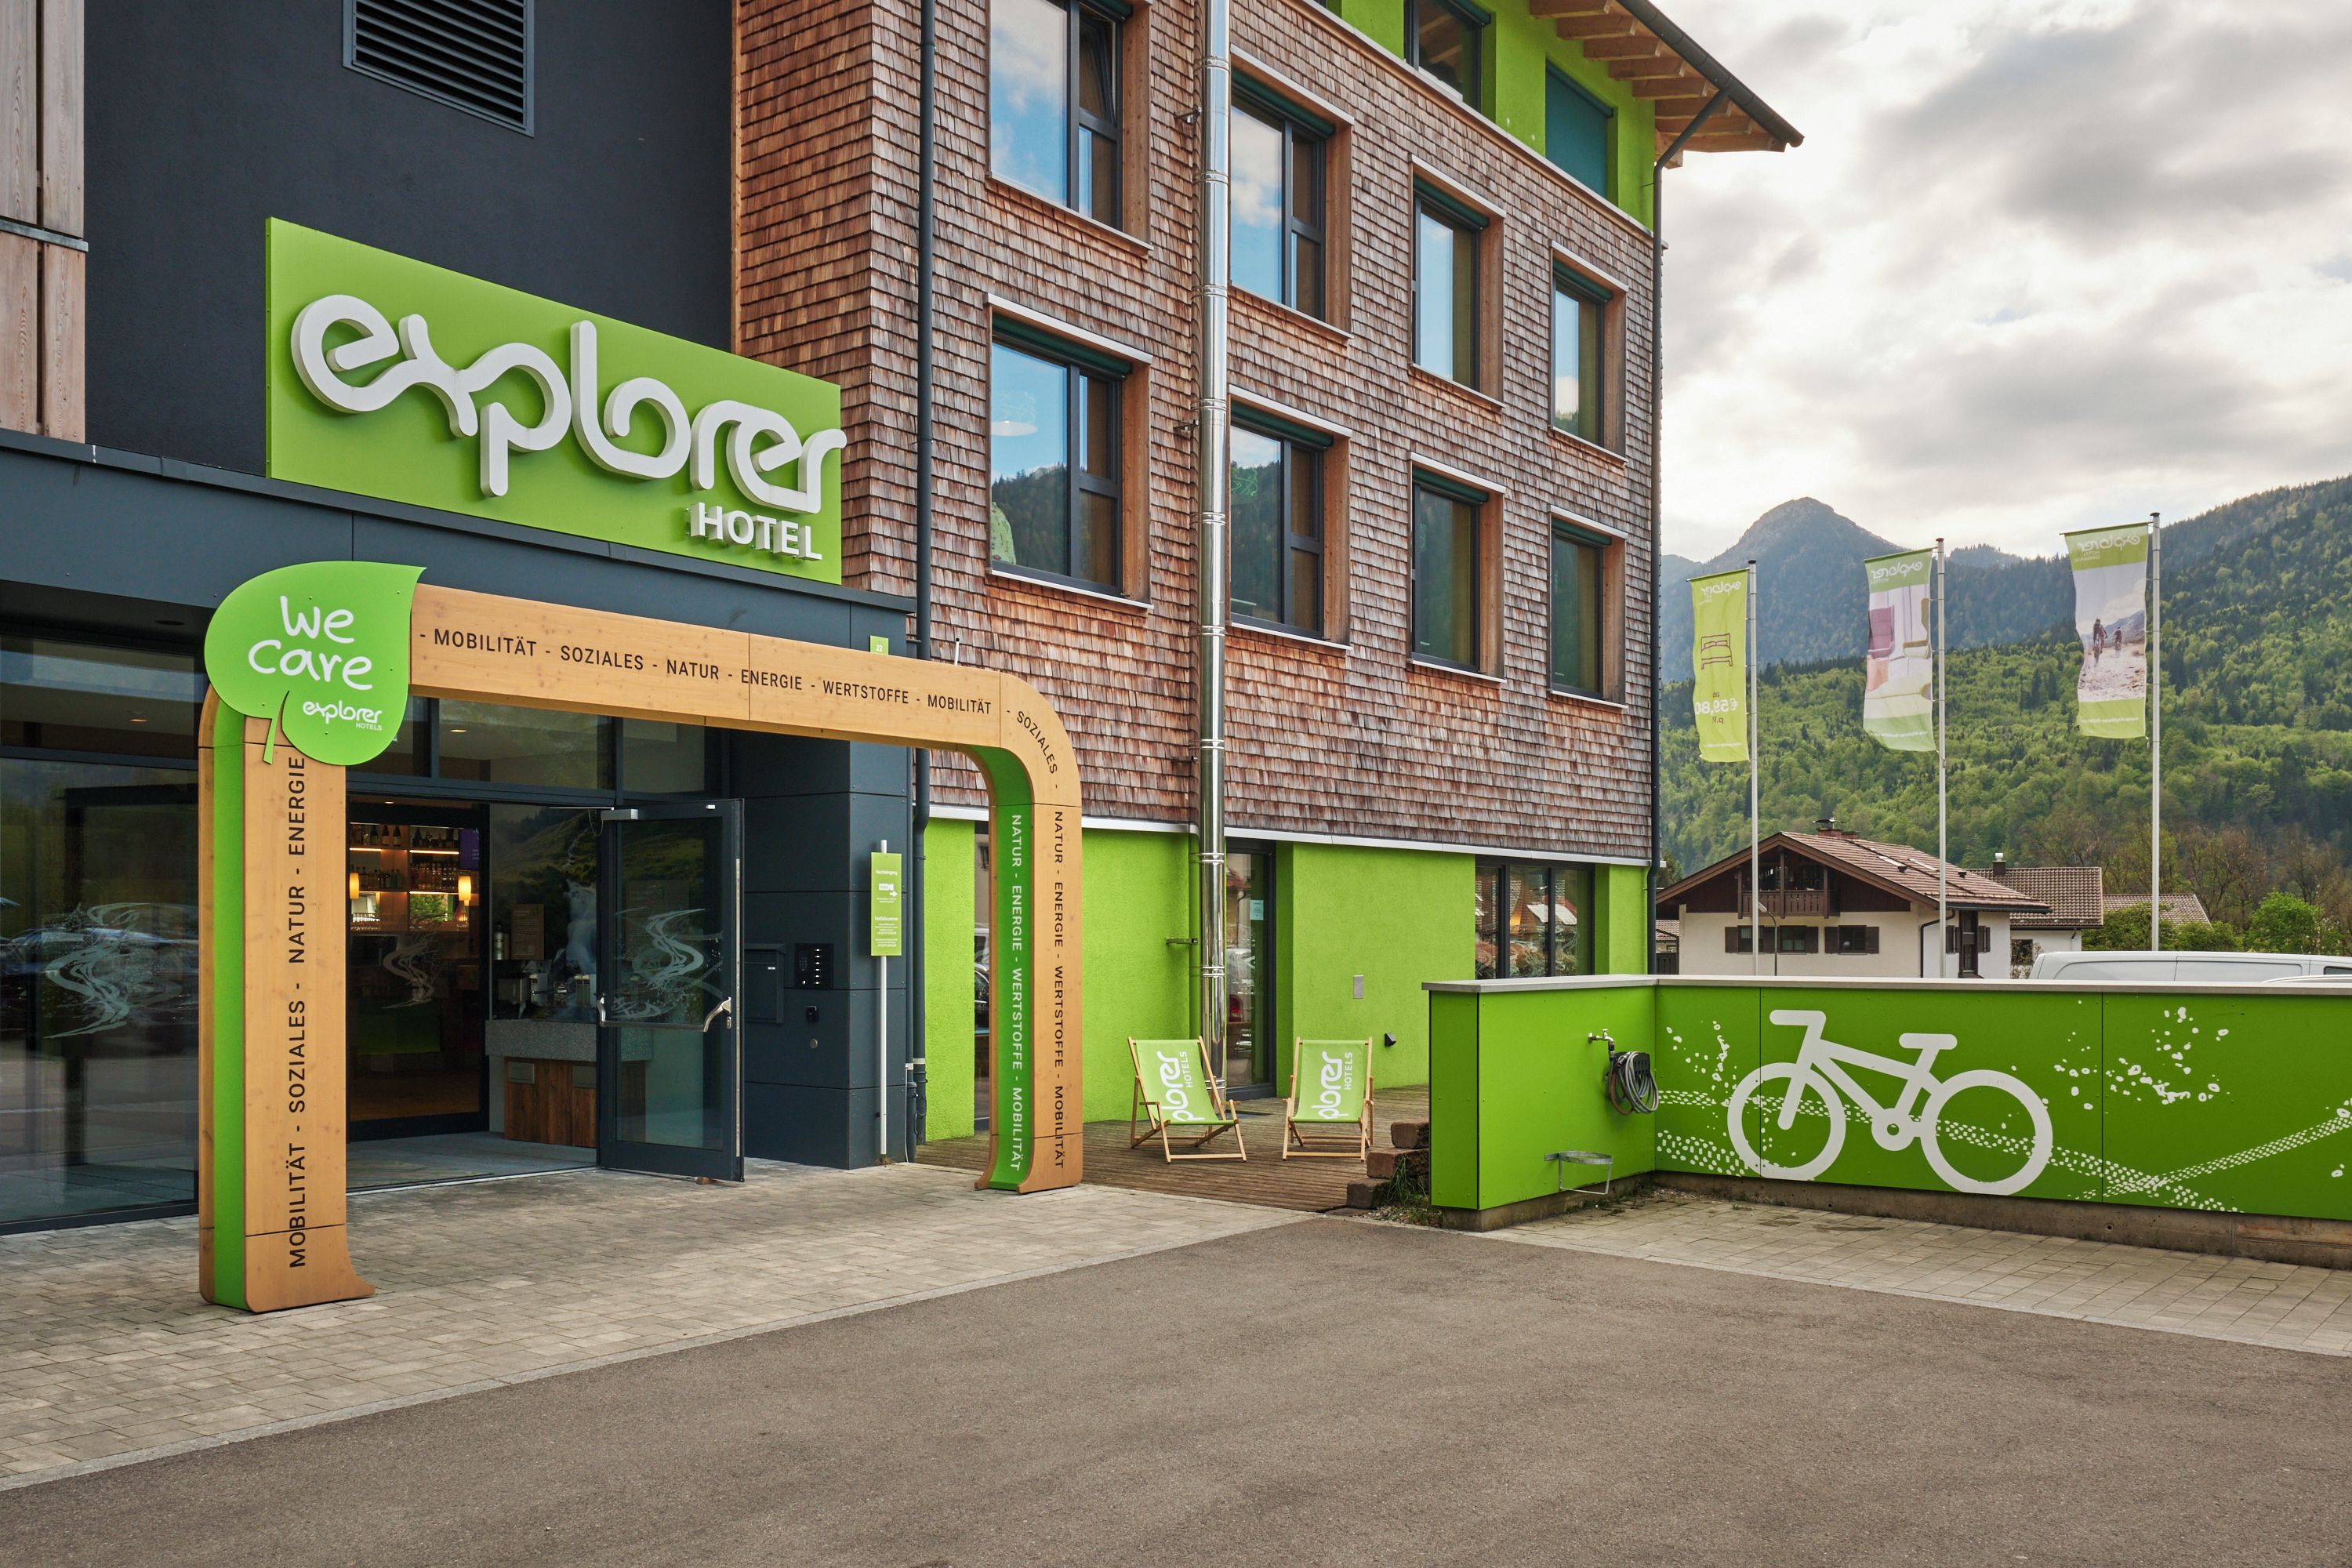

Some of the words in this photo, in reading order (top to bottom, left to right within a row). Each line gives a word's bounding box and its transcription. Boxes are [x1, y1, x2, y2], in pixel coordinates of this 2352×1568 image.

[291, 294, 848, 514] explorer
[691, 502, 822, 561] HOTEL
[303, 699, 383, 724] explorer
[355, 722, 383, 731] HOTELS
[434, 629, 537, 656] MOBILITÄT
[561, 644, 644, 670] SOZIALES
[666, 659, 719, 680] NATUR
[741, 669, 802, 691] ENERGIE
[822, 680, 909, 704] WERTSTOFFE
[927, 694, 992, 714] MOBILITÄT
[1016, 711, 1058, 774] SOZIALES
[289, 757, 305, 855] ENERGIE
[1012, 815, 1022, 867] NATUR
[1054, 811, 1063, 863] NATUR
[289, 886, 305, 964] NATUR
[1012, 885, 1022, 951] ENERGIE
[1054, 882, 1063, 948] ENERGIE
[1012, 968, 1022, 1070] WERTSTOFFE
[1054, 966, 1063, 1068] WERTSTOFFE
[289, 1000, 305, 1112] SOZIALES
[1156, 1051, 1205, 1122] plorer
[1179, 1051, 1193, 1088] HOTELS
[1311, 1051, 1349, 1120] plorer
[1345, 1052, 1353, 1091] HOTELS
[1010, 1087, 1023, 1171] MOBILITÄT
[1054, 1086, 1065, 1168] MOBILITÄT
[286, 1143, 306, 1268] MOBILITÄT
